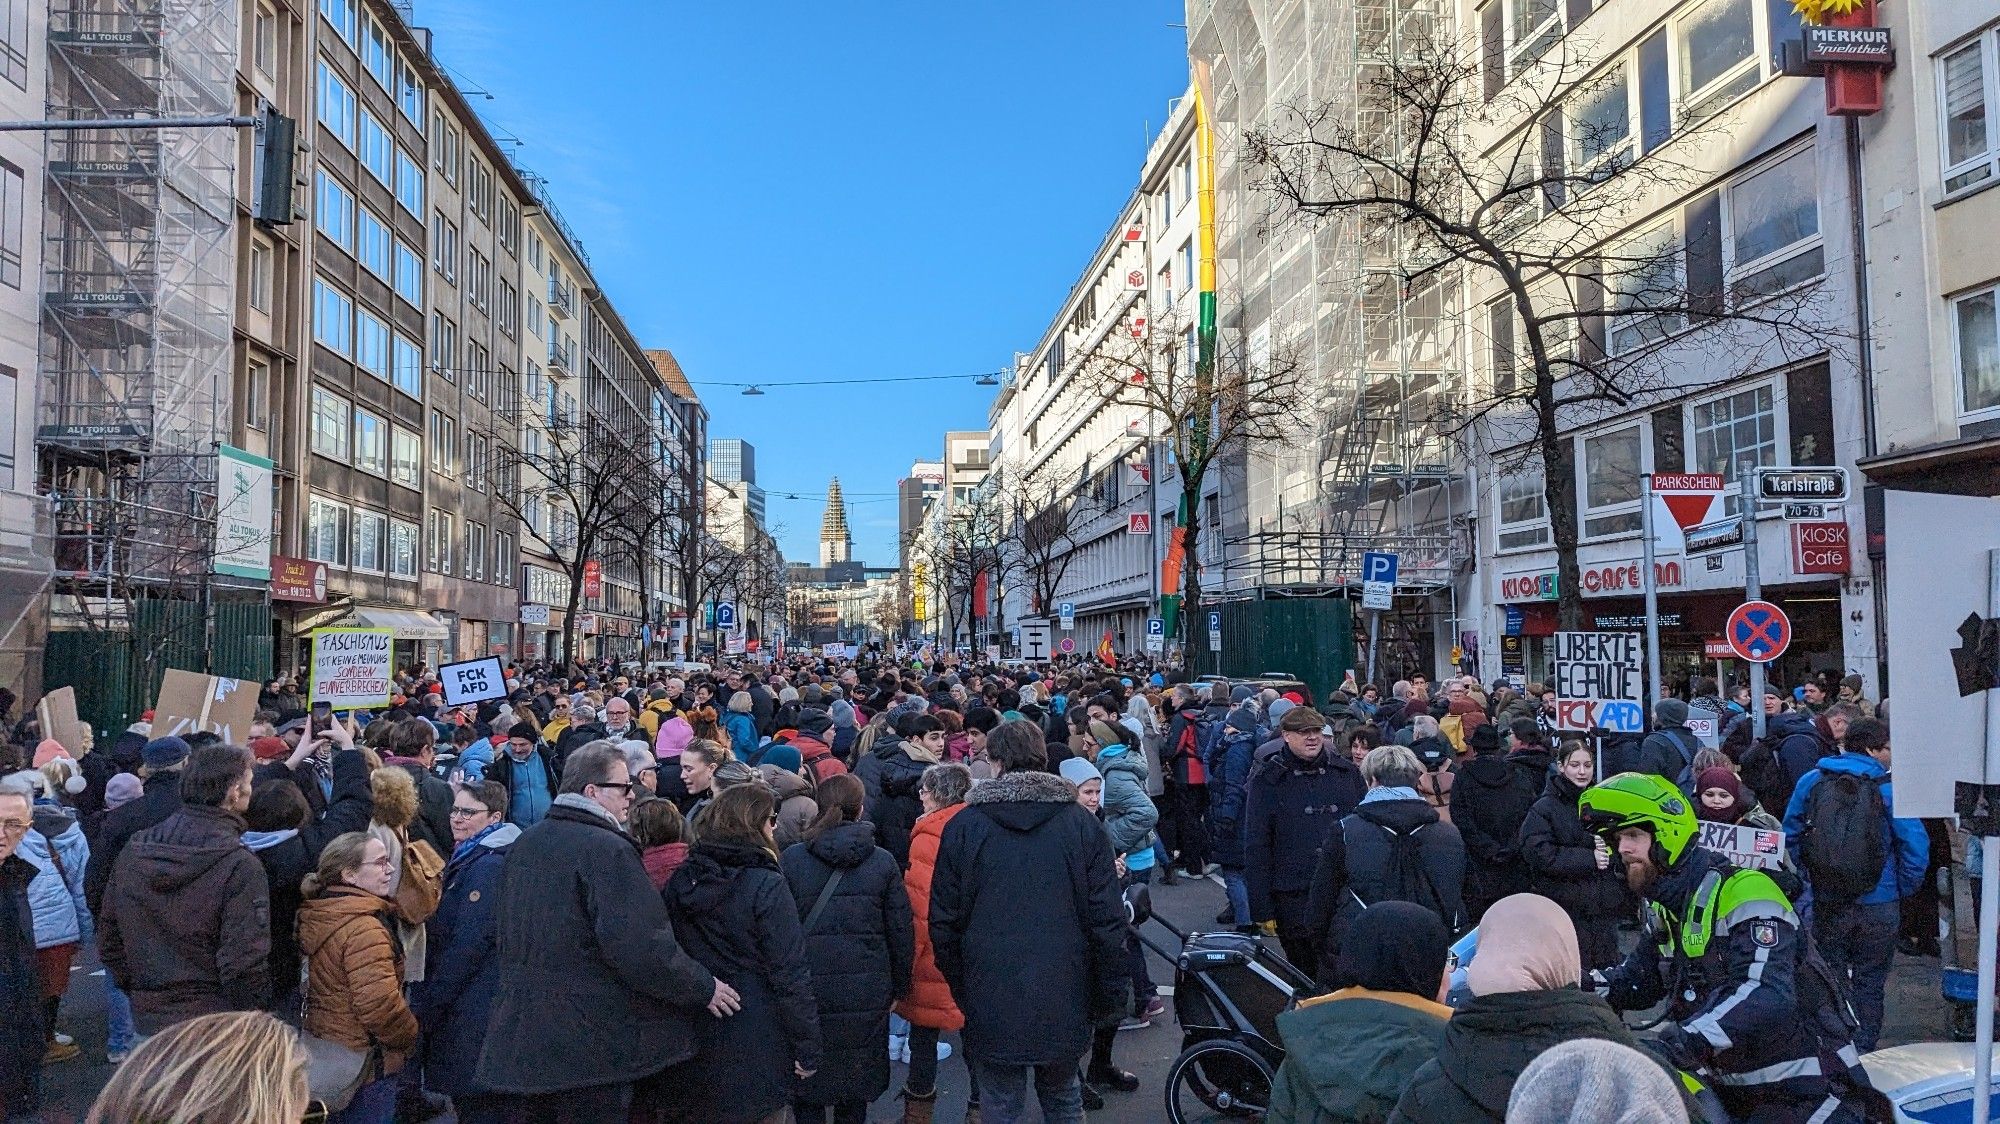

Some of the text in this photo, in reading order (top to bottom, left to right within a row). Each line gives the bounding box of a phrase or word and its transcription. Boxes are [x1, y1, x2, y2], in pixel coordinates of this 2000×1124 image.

[80, 33, 132, 41] ALI TOKUS
[1812, 29, 1888, 43] MERKUR
[1814, 42, 1888, 56] Spielothek
[94, 163, 129, 171] TOKUS
[72, 293, 126, 301] ALI TOKUS
[67, 426, 121, 434] ALI TOKUS
[1655, 476, 1721, 490] PARKSCHEIN
[1772, 476, 1835, 495] Karlstraße
[230, 524, 261, 537] ALI TOKUS
[1801, 526, 1847, 543] KIOSK
[1802, 550, 1843, 566] Café
[1502, 574, 1542, 599] KIOS
[1583, 561, 1640, 592] CAFÉ
[722, 609, 730, 621] P
[1150, 620, 1161, 634] P
[320, 633, 389, 651] FASCHISMUS
[318, 656, 332, 667] IST
[332, 654, 358, 667] KEINE
[333, 665, 377, 678] SONDERN
[456, 667, 487, 682] FCK
[333, 679, 388, 694] VERBRECHEN
[460, 681, 489, 694] AFD
[1558, 700, 1644, 731] FCK AFD
[1697, 821, 1738, 851] ERTA
